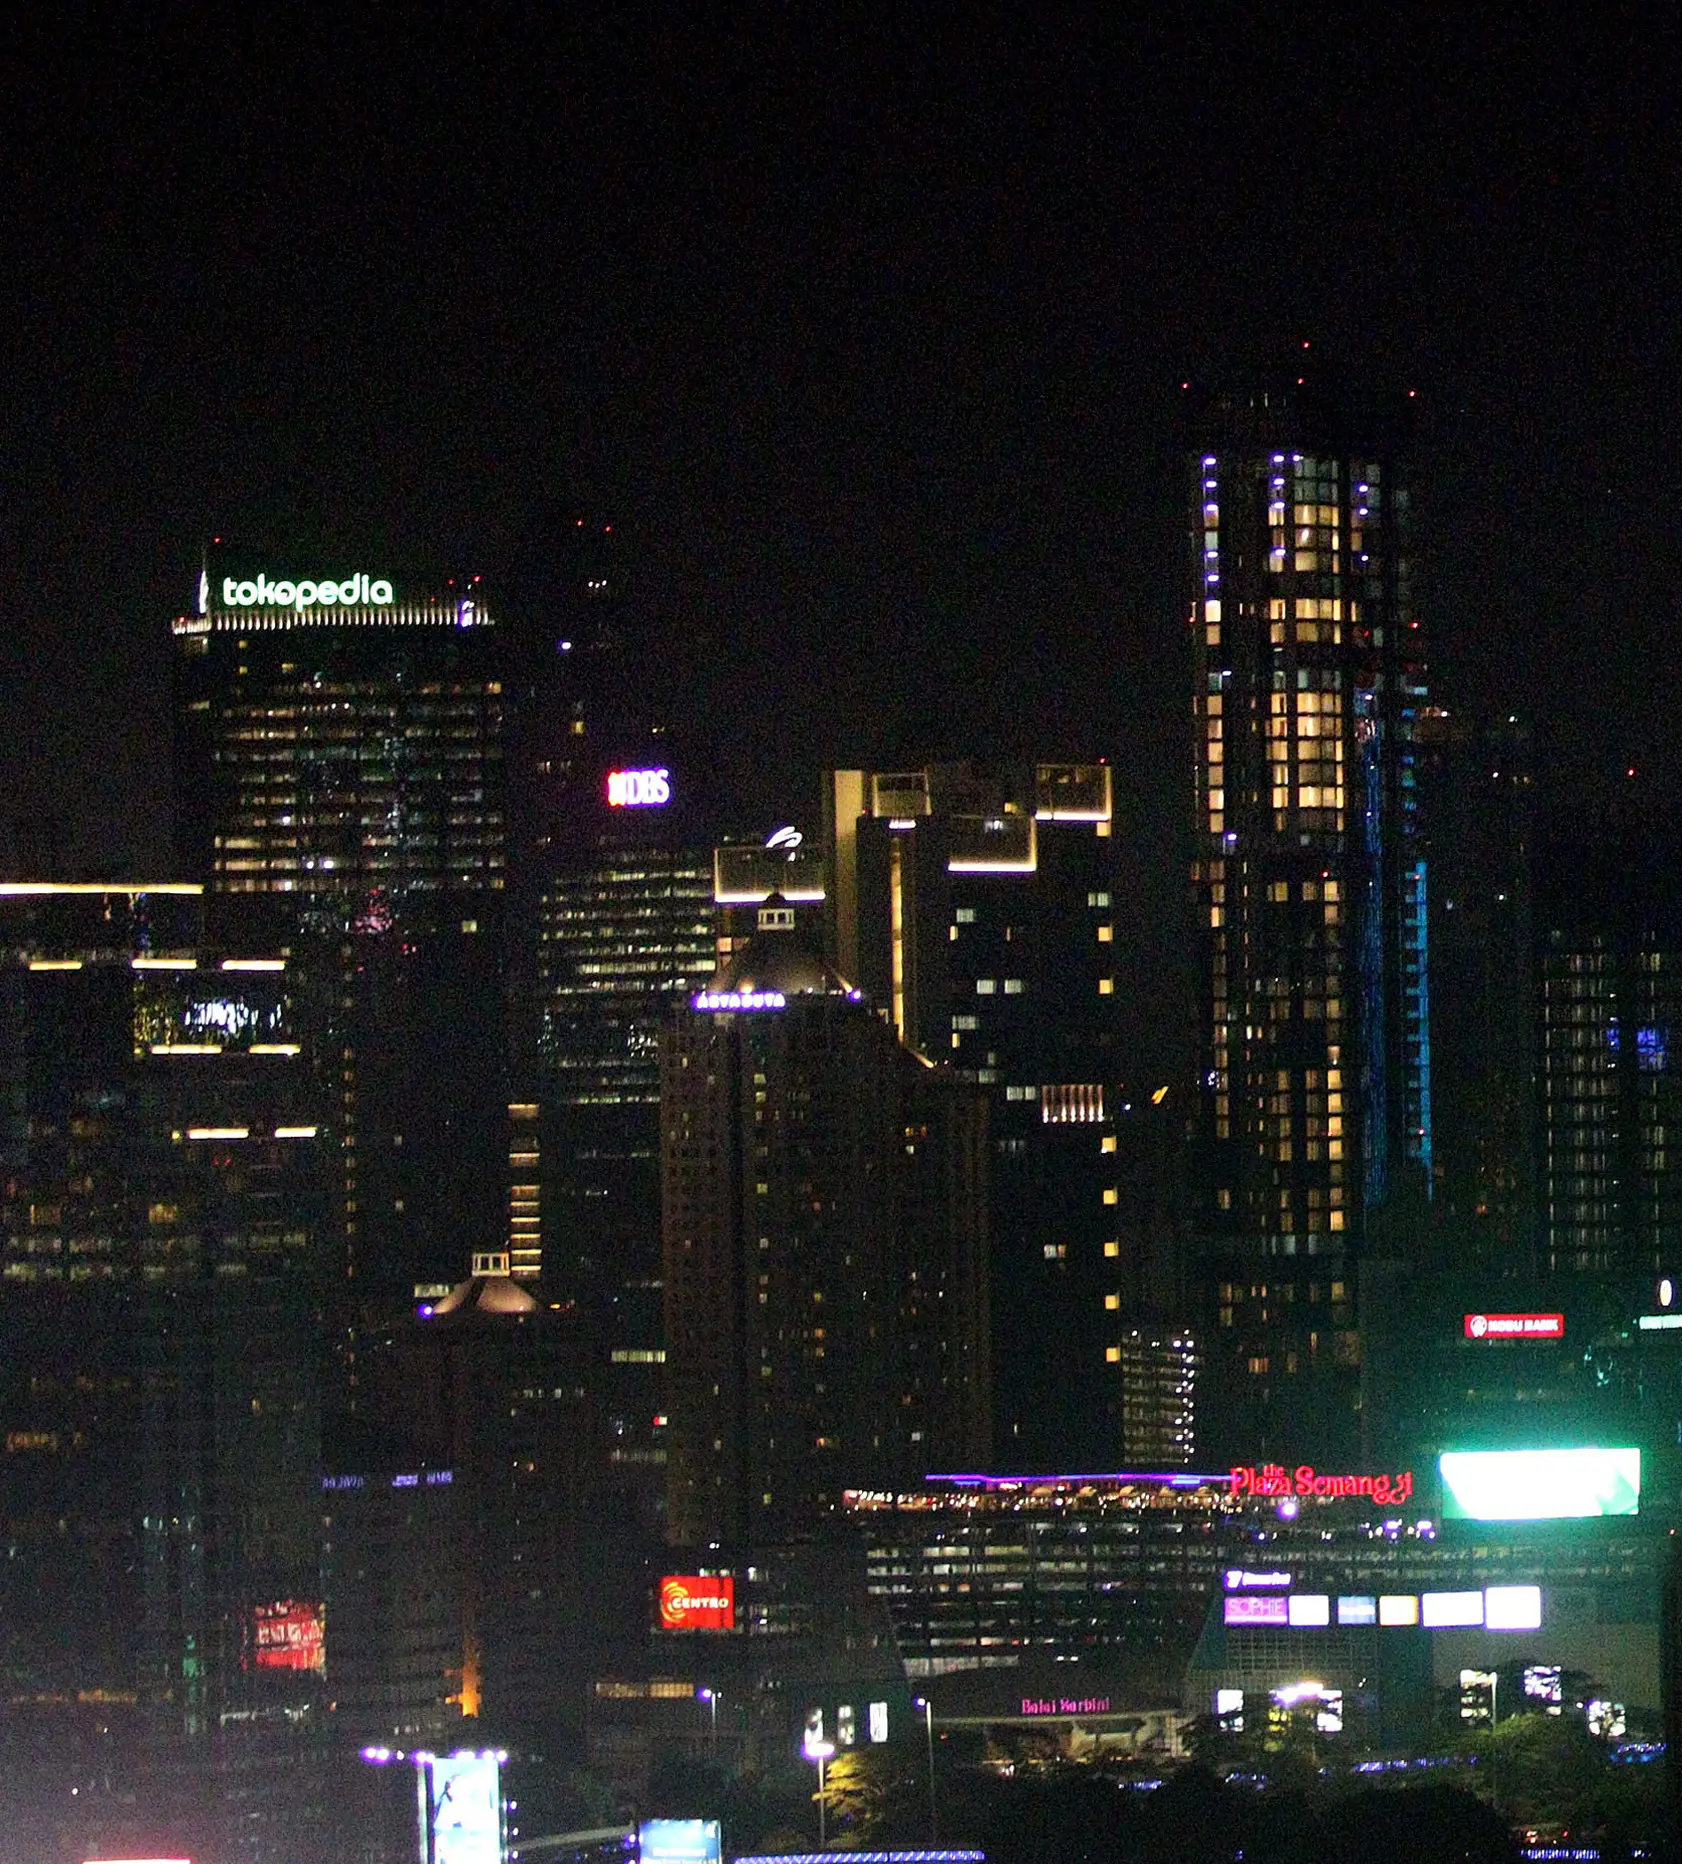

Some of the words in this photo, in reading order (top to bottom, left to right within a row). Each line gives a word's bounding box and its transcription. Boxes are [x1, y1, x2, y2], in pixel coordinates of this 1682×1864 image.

[223, 572, 393, 612] tokopedia
[628, 769, 670, 805] DBS
[1524, 1319, 1559, 1332] BANK
[1230, 1465, 1293, 1497] Plaza
[1294, 1465, 1413, 1505] Semanggi
[671, 1597, 729, 1609] CENTRO
